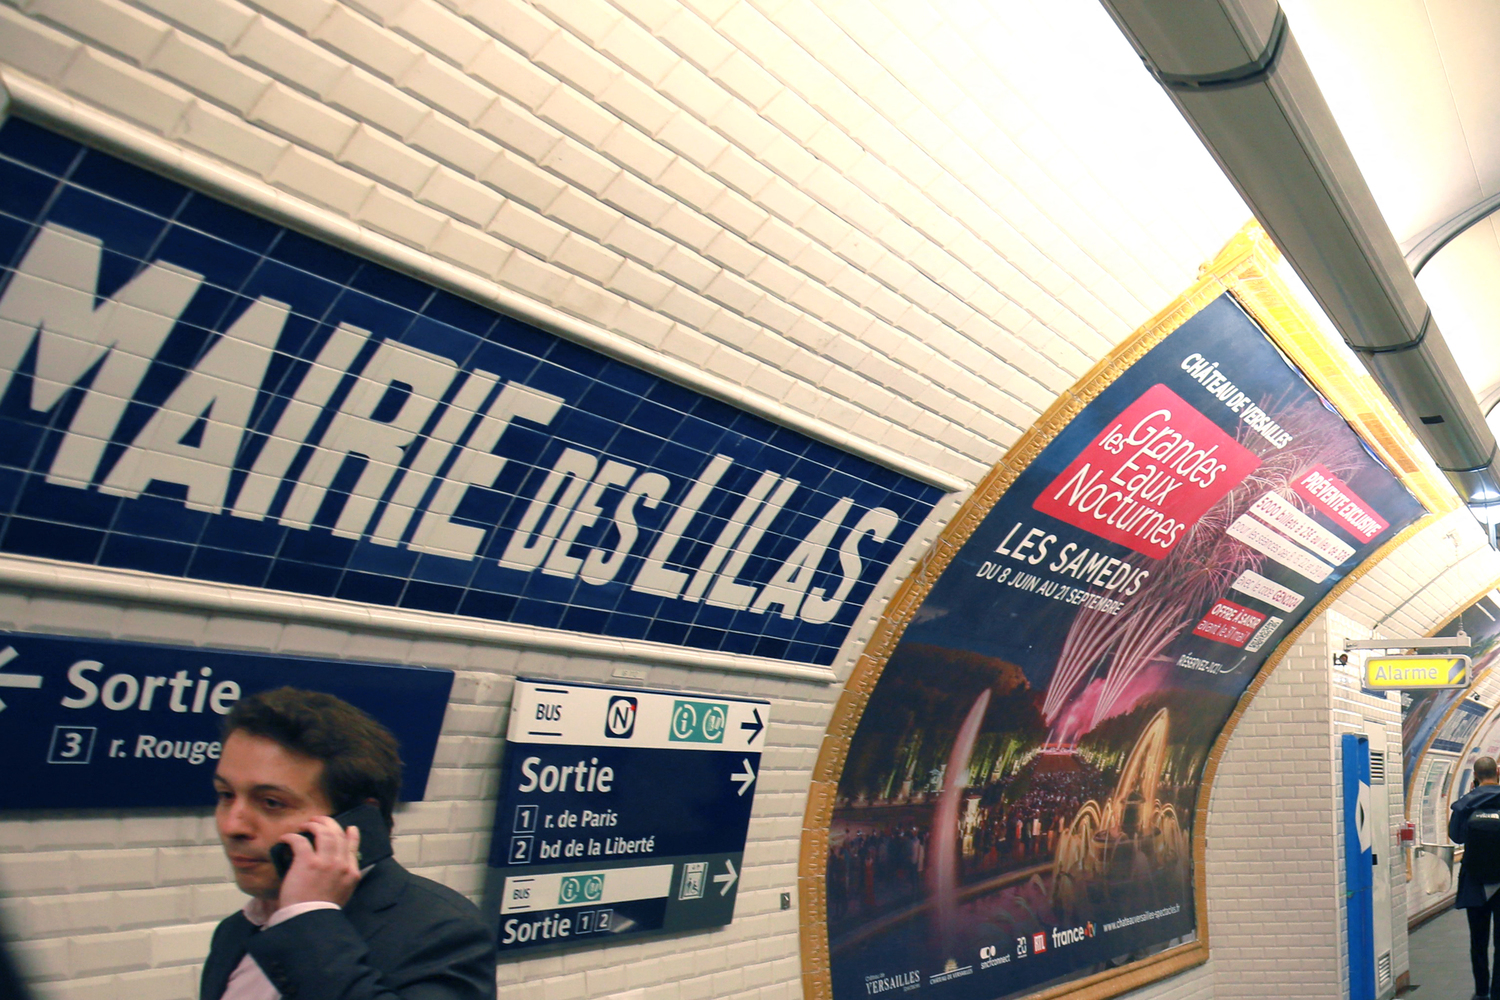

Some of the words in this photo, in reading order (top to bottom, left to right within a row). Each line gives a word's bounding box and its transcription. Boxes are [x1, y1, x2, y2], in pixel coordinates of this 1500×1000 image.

[1181, 353, 1238, 401] CHÂTEAU
[1225, 392, 1251, 413] DE
[1239, 403, 1293, 449] VERSAILLES
[0, 221, 565, 562] MAIRIE
[498, 448, 670, 585] DES
[631, 454, 899, 624] LILAS
[1098, 423, 1129, 455] les
[1128, 409, 1227, 489] Grandes
[1110, 445, 1184, 506] Eaux
[1054, 463, 1186, 548] Nocturnes
[1256, 497, 1281, 516] 5000
[1275, 510, 1299, 530] billets
[1300, 471, 1350, 512] PRÉVENTE
[1338, 501, 1382, 538] EXCLUSIVE
[995, 522, 1057, 565] LES
[1050, 542, 1149, 596] SAMEDIS
[976, 561, 1002, 580] DU
[999, 567, 1012, 583] 8
[1007, 571, 1041, 592] JUIN
[1035, 580, 1057, 598] AU
[1054, 585, 1070, 601] 21
[1066, 588, 1125, 616] SEPTEMBRE
[1211, 603, 1238, 621] OFFRE
[60, 660, 241, 715] Sortie
[1375, 665, 1437, 680] Alarme
[536, 703, 562, 721] BUS
[60, 733, 82, 757] 3
[109, 739, 126, 757] r.
[518, 757, 614, 793] Sortie
[521, 810, 530, 827] 1
[544, 812, 554, 828] r.
[558, 810, 577, 828] de
[581, 809, 618, 828] Paris
[515, 841, 526, 858] 2
[540, 840, 562, 859] bd
[565, 839, 583, 857] de
[587, 838, 601, 856] la
[605, 835, 655, 855] Liberté
[513, 888, 531, 900] BUS
[502, 913, 571, 944] Sortie
[581, 916, 589, 930] 1
[599, 913, 608, 928] 2
[866, 970, 920, 995] VERSAILLES
